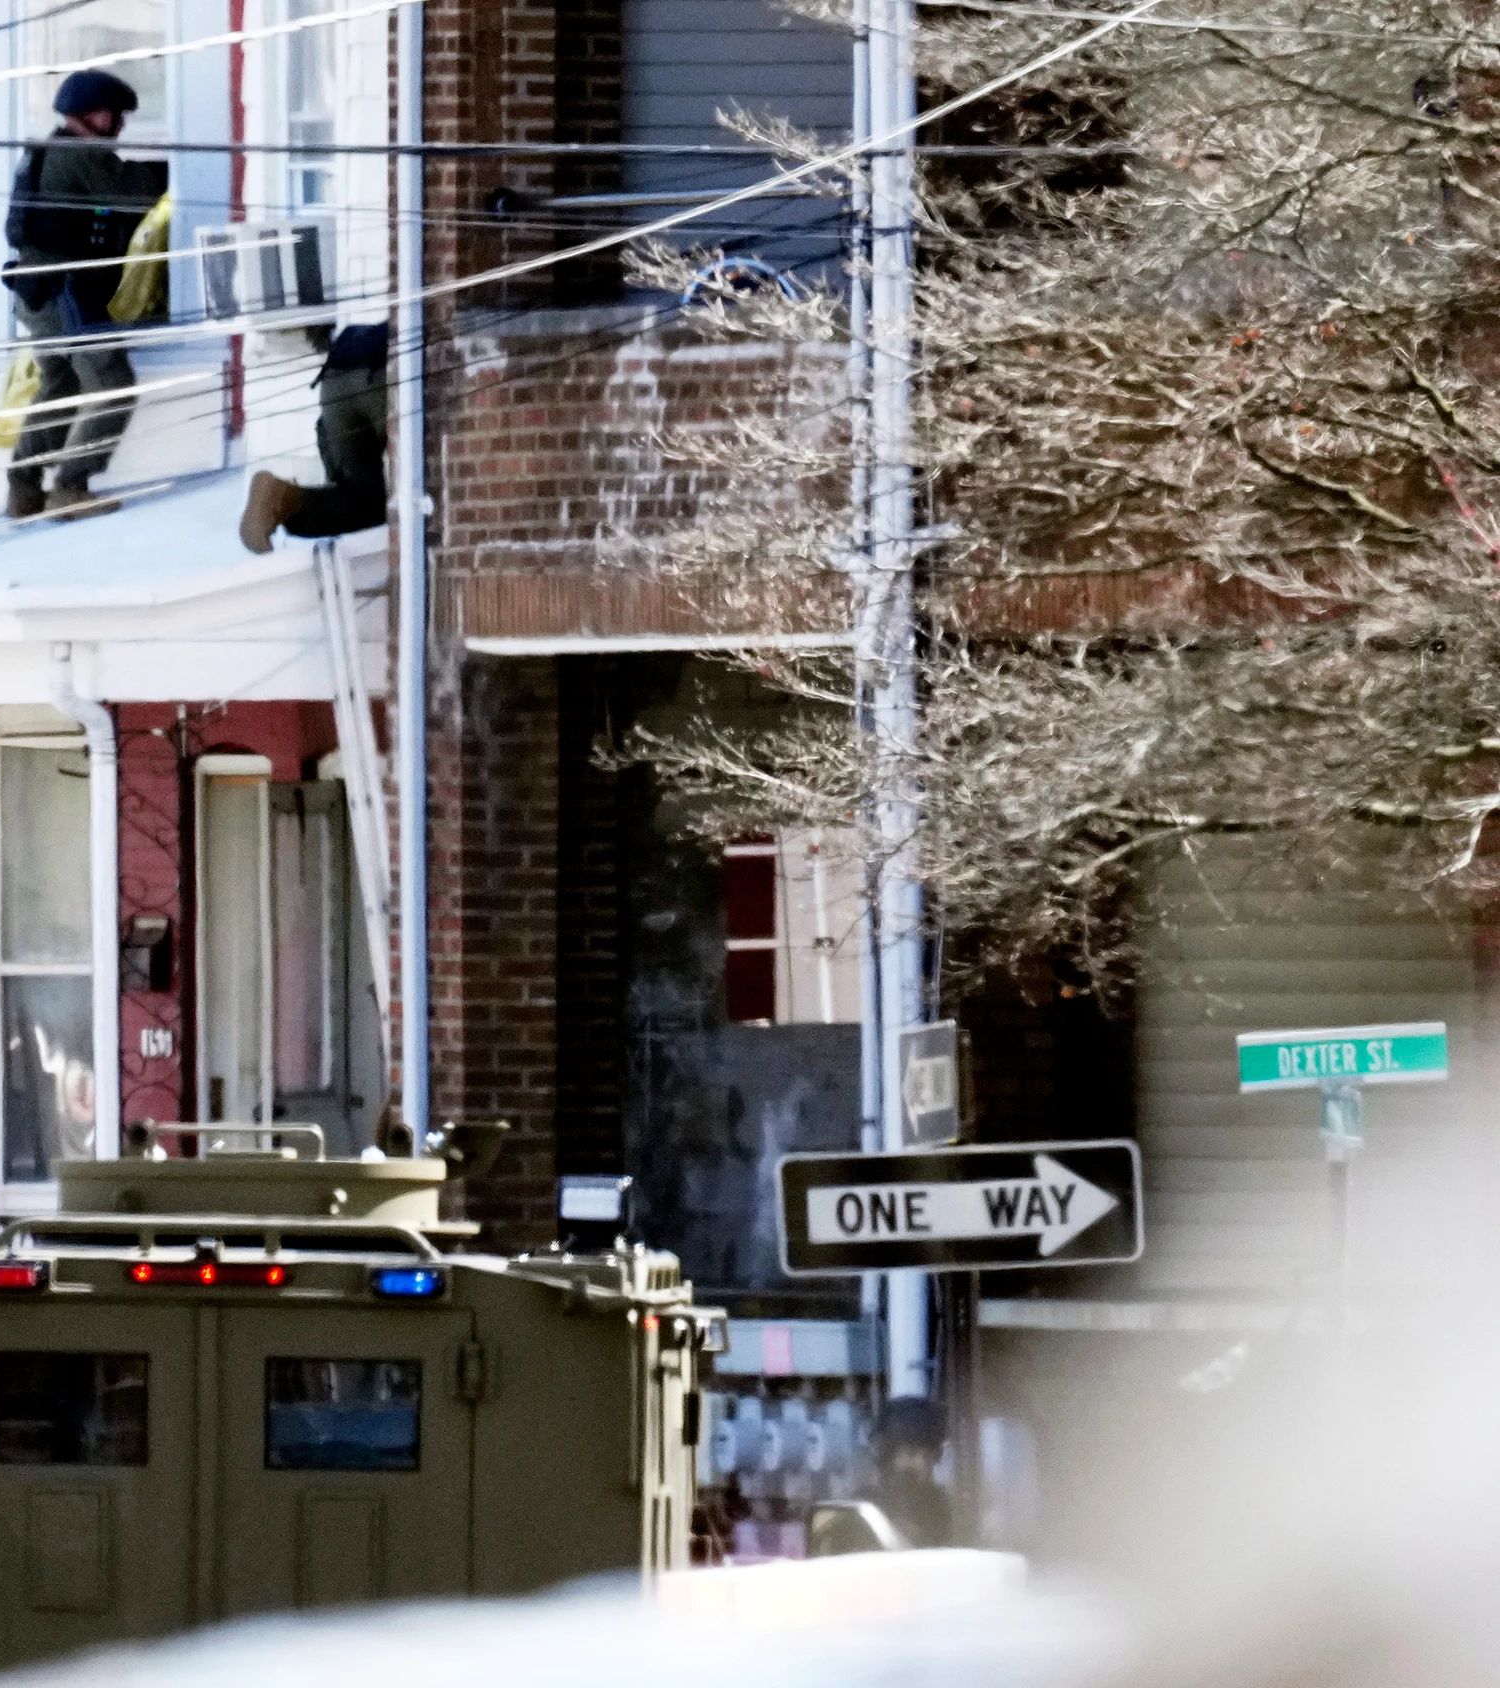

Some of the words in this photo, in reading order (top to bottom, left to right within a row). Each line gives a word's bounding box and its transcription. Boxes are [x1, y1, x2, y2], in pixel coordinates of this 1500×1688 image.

[1278, 1043, 1357, 1077] DEXTER
[1367, 1040, 1399, 1071] ST.
[835, 1191, 932, 1236] ONE
[983, 1183, 1077, 1228] WAY
